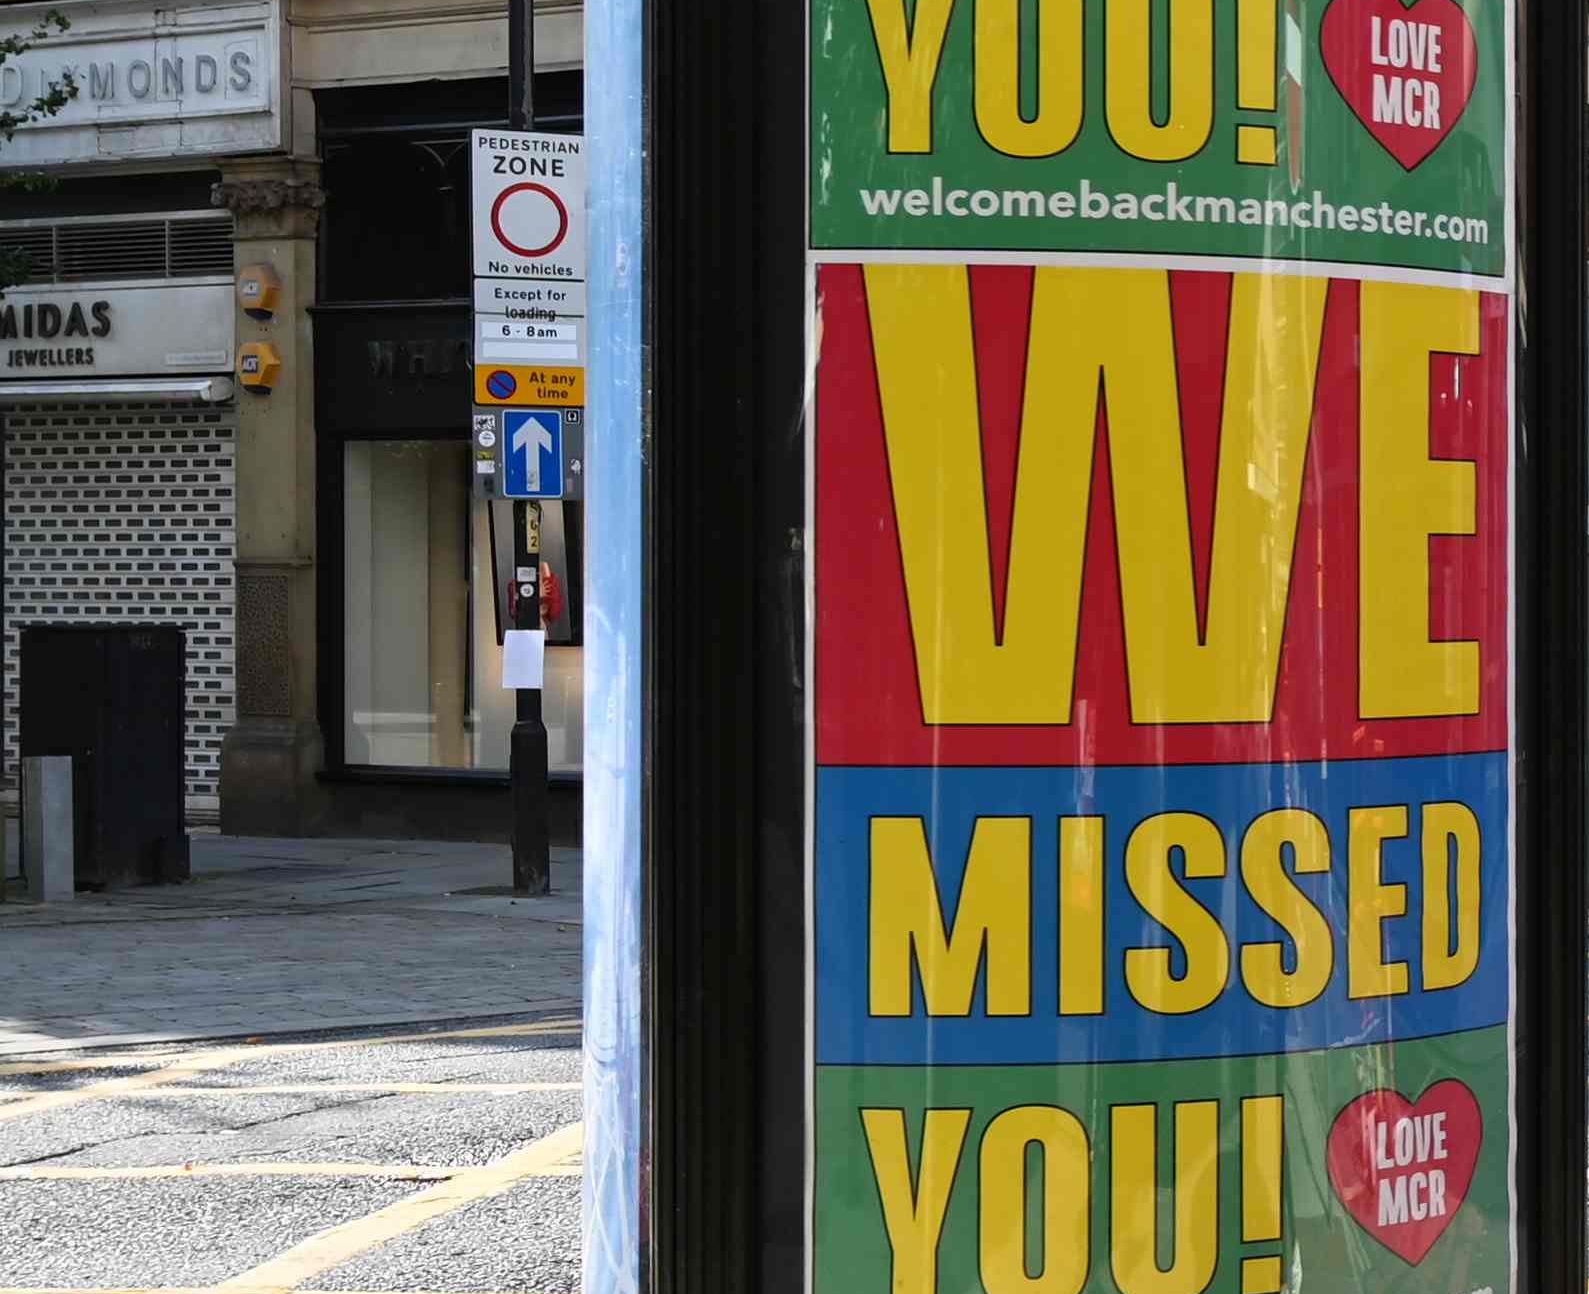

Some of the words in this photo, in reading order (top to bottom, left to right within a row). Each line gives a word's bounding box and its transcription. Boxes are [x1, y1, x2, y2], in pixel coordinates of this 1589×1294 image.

[1371, 16, 1442, 74] LOVE
[0, 51, 251, 107] DIMONDS
[1371, 74, 1441, 130] MCR
[478, 137, 579, 154] PEDESTRIAN
[493, 155, 564, 177] ZONE
[860, 176, 1489, 245] welcomebackmanchester.com
[488, 261, 509, 274] No
[514, 264, 573, 276] vehicles
[494, 288, 541, 301] Except
[547, 290, 566, 301] for
[505, 306, 556, 322] loading
[502, 325, 511, 336] 6
[7, 348, 94, 367] JEWELLERS
[529, 371, 547, 384] At
[551, 375, 576, 387] any
[537, 387, 568, 399] time
[862, 263, 1481, 726] WE
[868, 800, 1482, 1018] MISSED
[1377, 1111, 1447, 1169] LOVE
[1377, 1169, 1447, 1227] MCR
